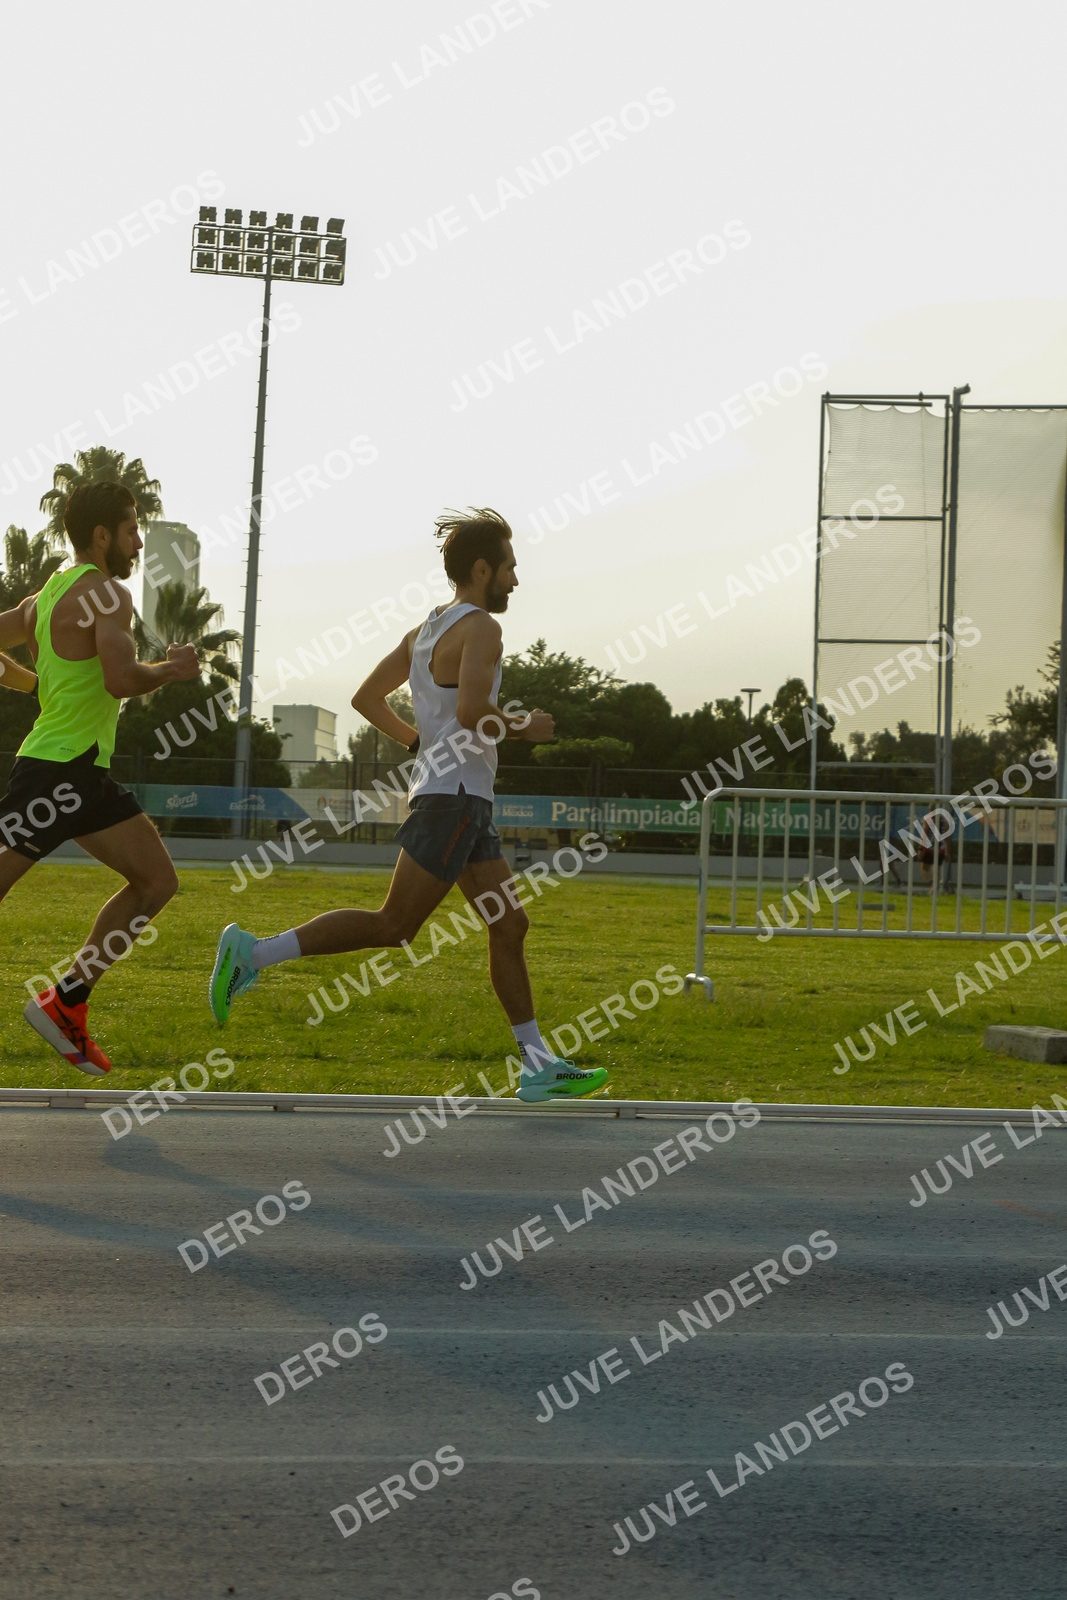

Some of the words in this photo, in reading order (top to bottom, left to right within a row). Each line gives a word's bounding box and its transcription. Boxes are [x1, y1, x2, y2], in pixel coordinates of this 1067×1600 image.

[551, 801, 701, 830] Paralimpiada
[725, 806, 831, 831] Nacional
[838, 813, 885, 831] 2026
[225, 965, 241, 1006] BROOKS
[556, 1072, 594, 1080] BROOKS
